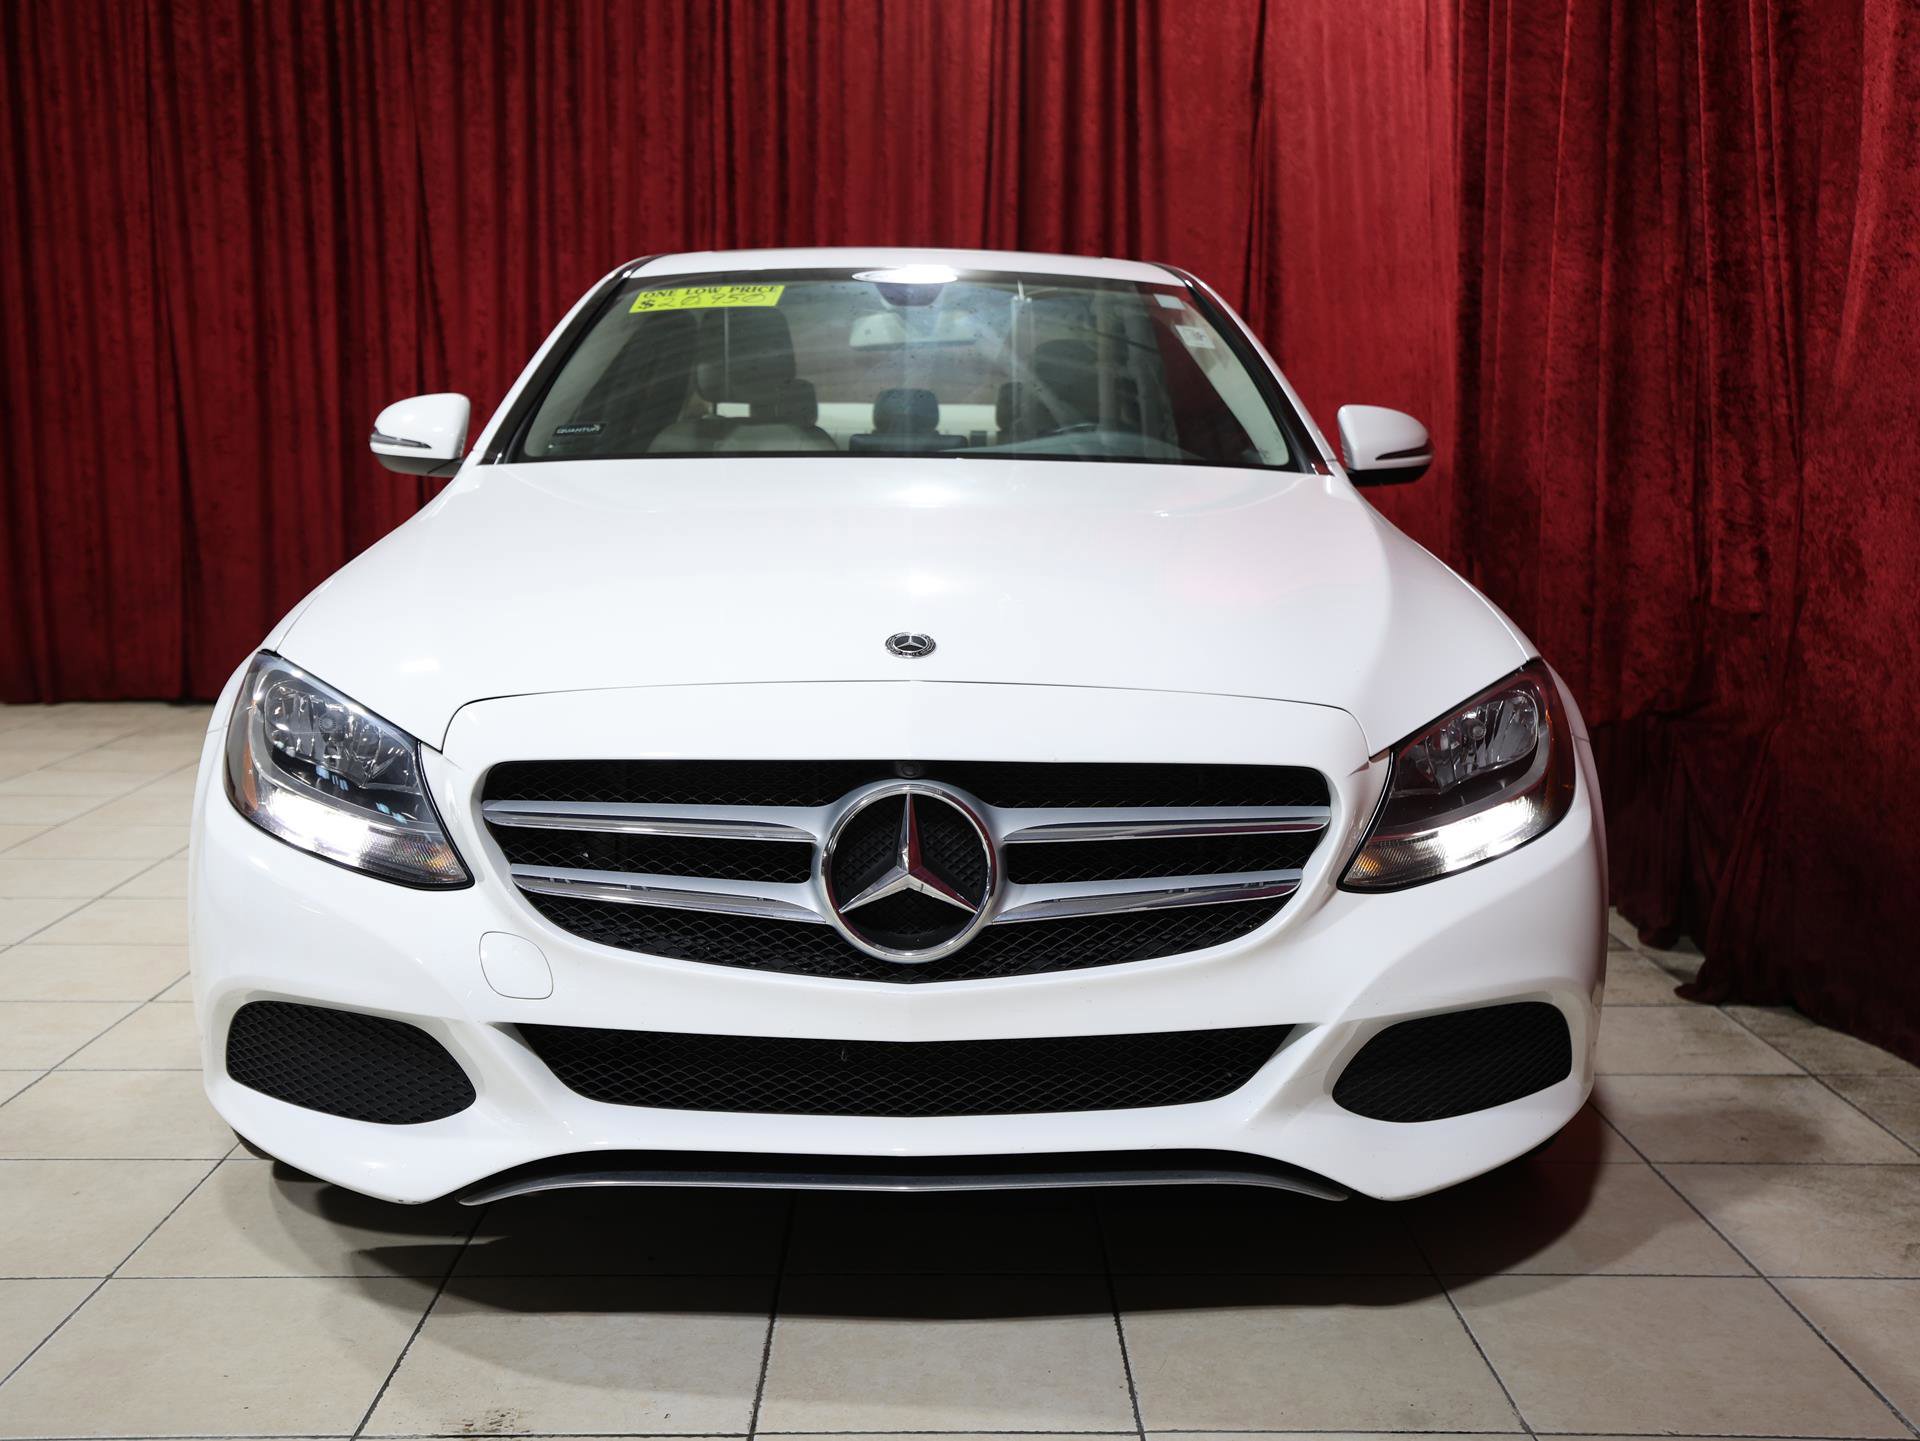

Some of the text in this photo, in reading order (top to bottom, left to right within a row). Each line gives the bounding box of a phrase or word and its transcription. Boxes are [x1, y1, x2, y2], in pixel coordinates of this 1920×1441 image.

[643, 285, 777, 298] ONE LOW PRICE
